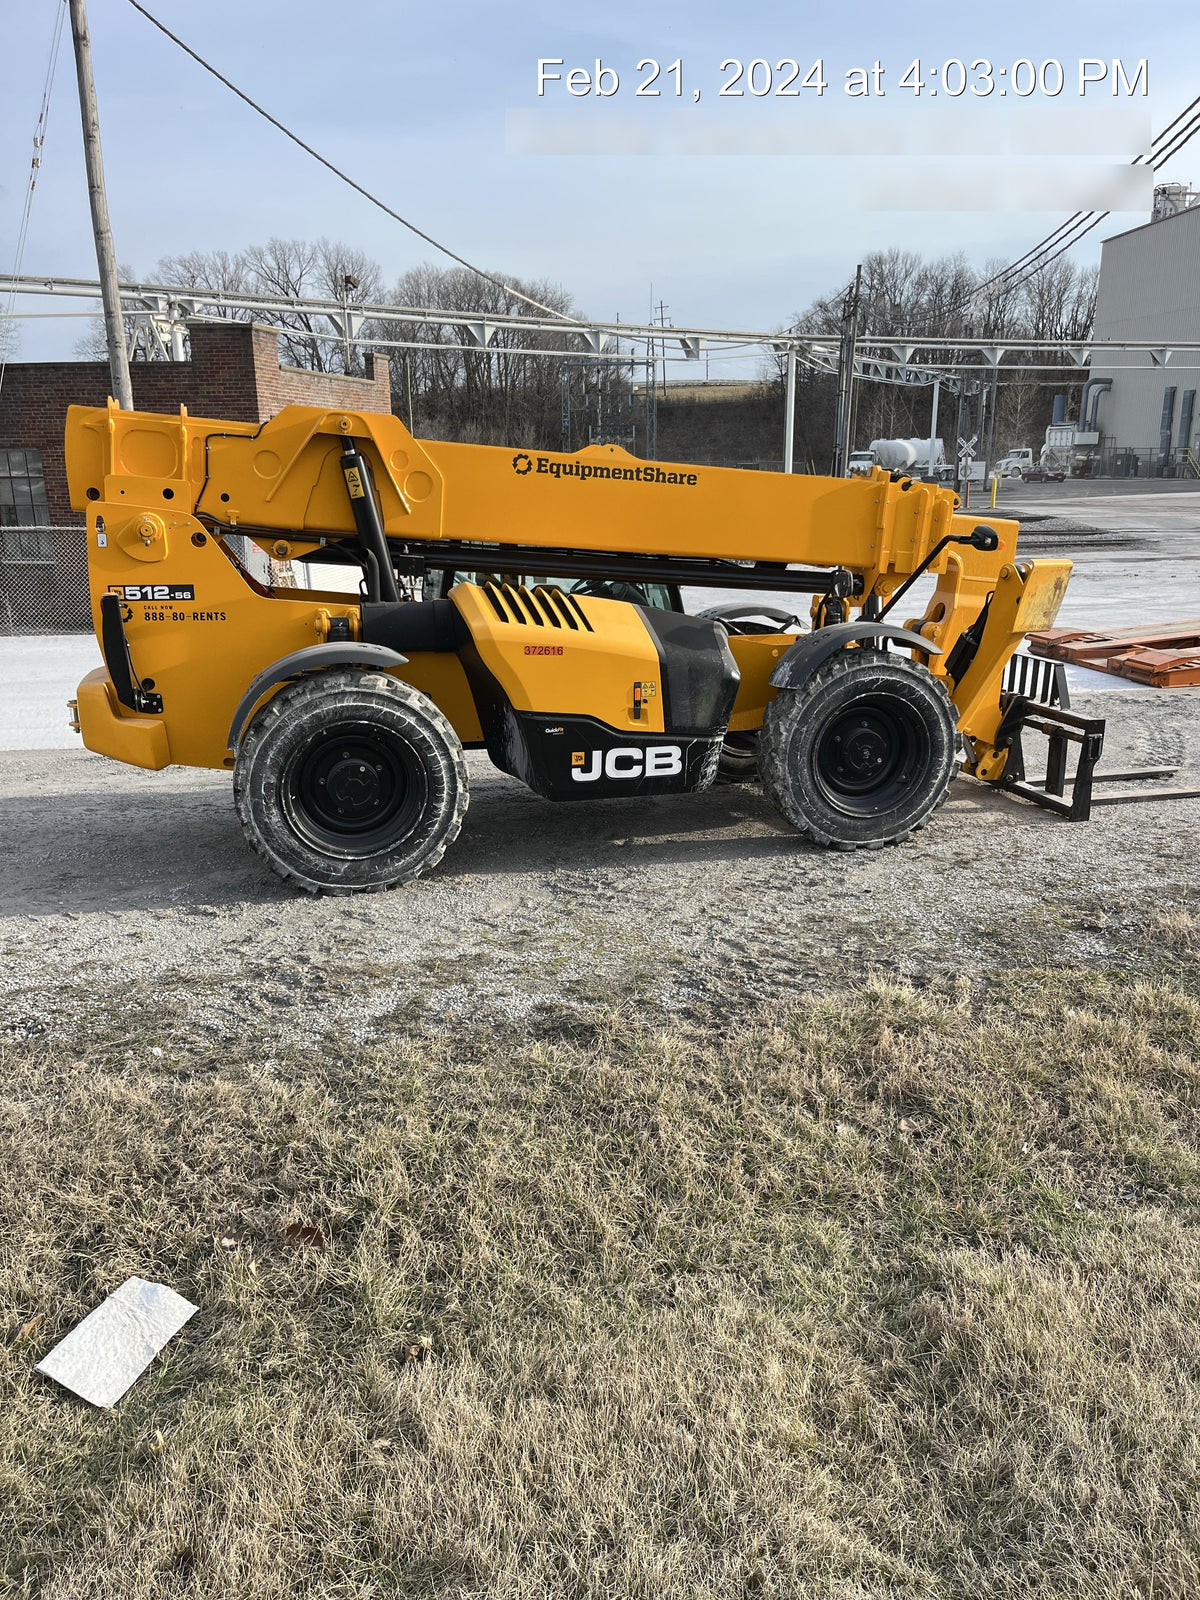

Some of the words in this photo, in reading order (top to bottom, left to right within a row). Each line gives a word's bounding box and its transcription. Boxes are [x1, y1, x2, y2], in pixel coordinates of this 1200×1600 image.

[536, 457, 698, 486] EquipmentShare
[144, 612, 226, 621] 888-80-RENTS
[524, 645, 564, 656] 372616
[571, 745, 682, 782] JCB
